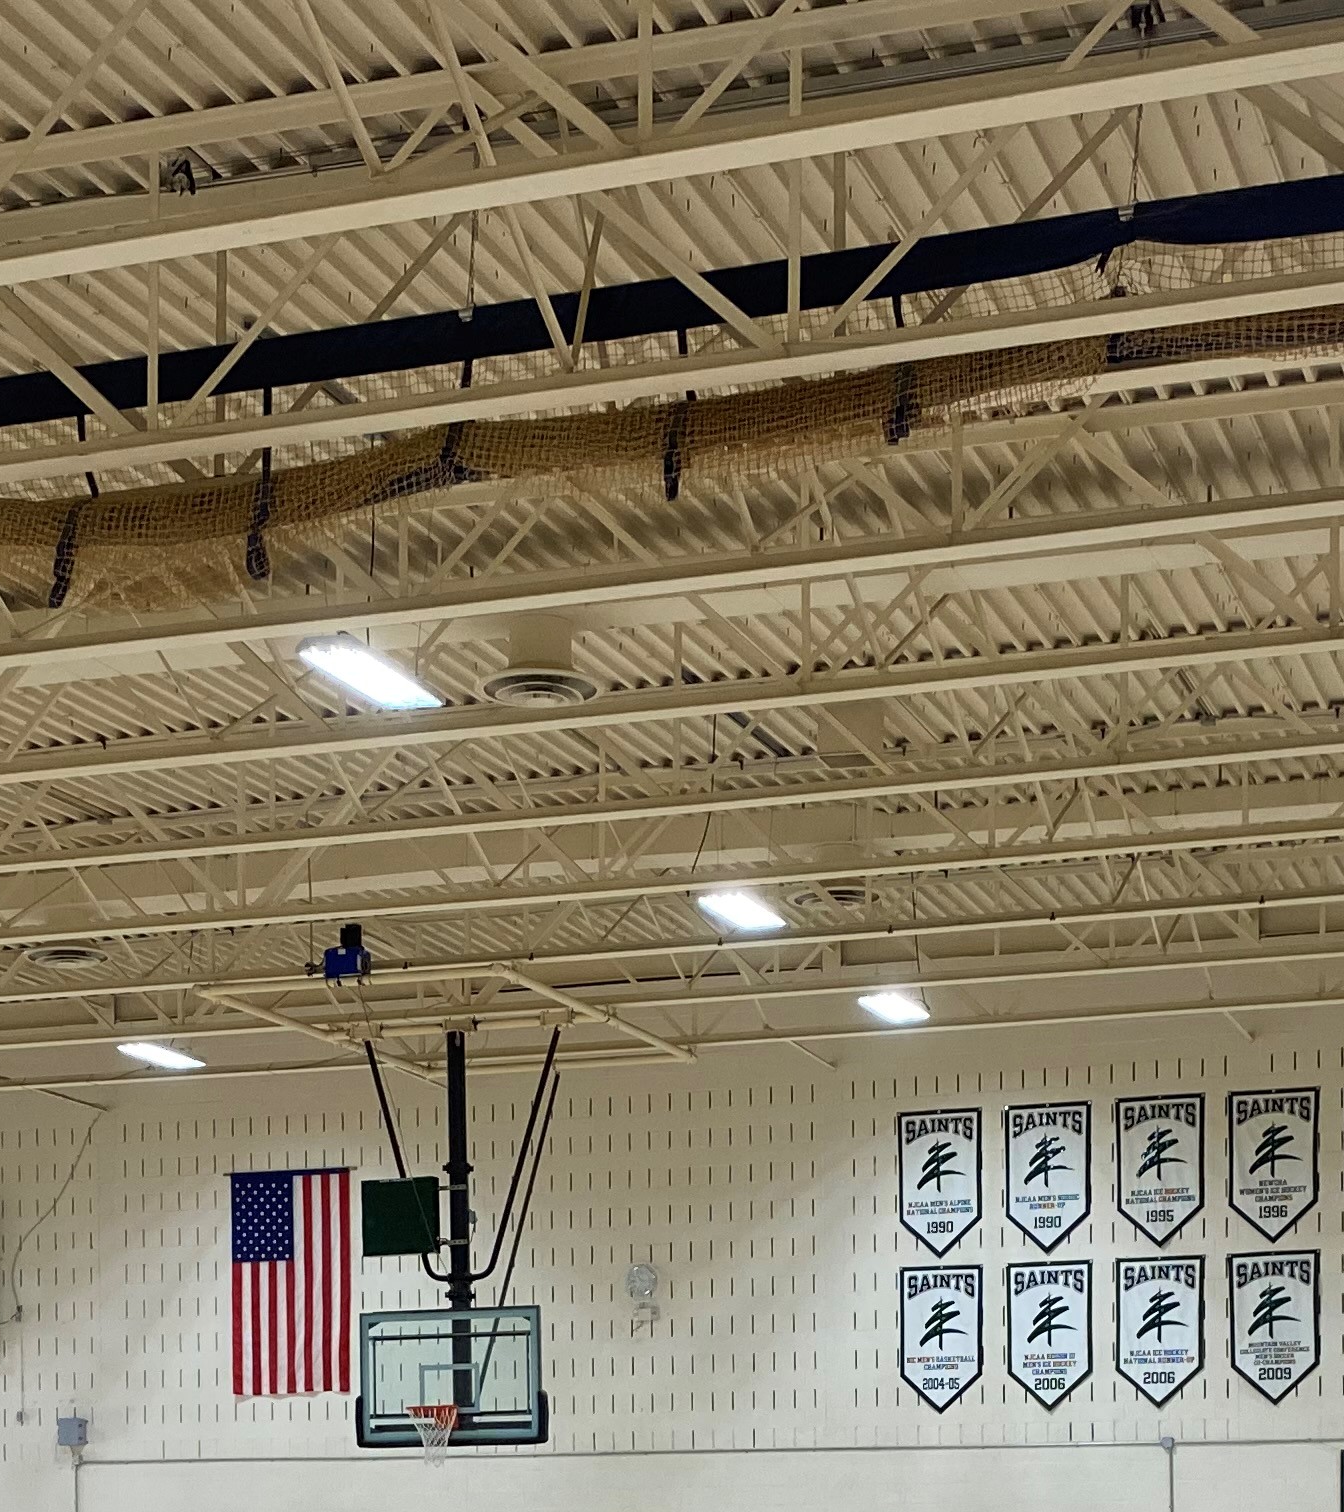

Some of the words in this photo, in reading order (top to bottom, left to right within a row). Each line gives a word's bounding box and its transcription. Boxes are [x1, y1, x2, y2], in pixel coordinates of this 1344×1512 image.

[1125, 1103, 1195, 1130] SAINTS
[1237, 1097, 1311, 1125] SAINTS
[906, 1117, 973, 1145] SAINTS
[1013, 1111, 1083, 1138] SAINTS
[1146, 1210, 1174, 1223] 1995
[1259, 1206, 1287, 1218] 1996
[927, 1221, 953, 1234] 1990
[1034, 1216, 1061, 1229] 1990
[1014, 1270, 1084, 1295] SAINTS
[1124, 1264, 1195, 1291] SAINTS
[1236, 1260, 1311, 1288] SAINTS
[908, 1273, 975, 1299] SAINTS
[923, 1378, 959, 1389] 2004-05
[1144, 1372, 1175, 1384] 2006
[1259, 1368, 1291, 1380] 2009
[1035, 1378, 1065, 1390] 2006
